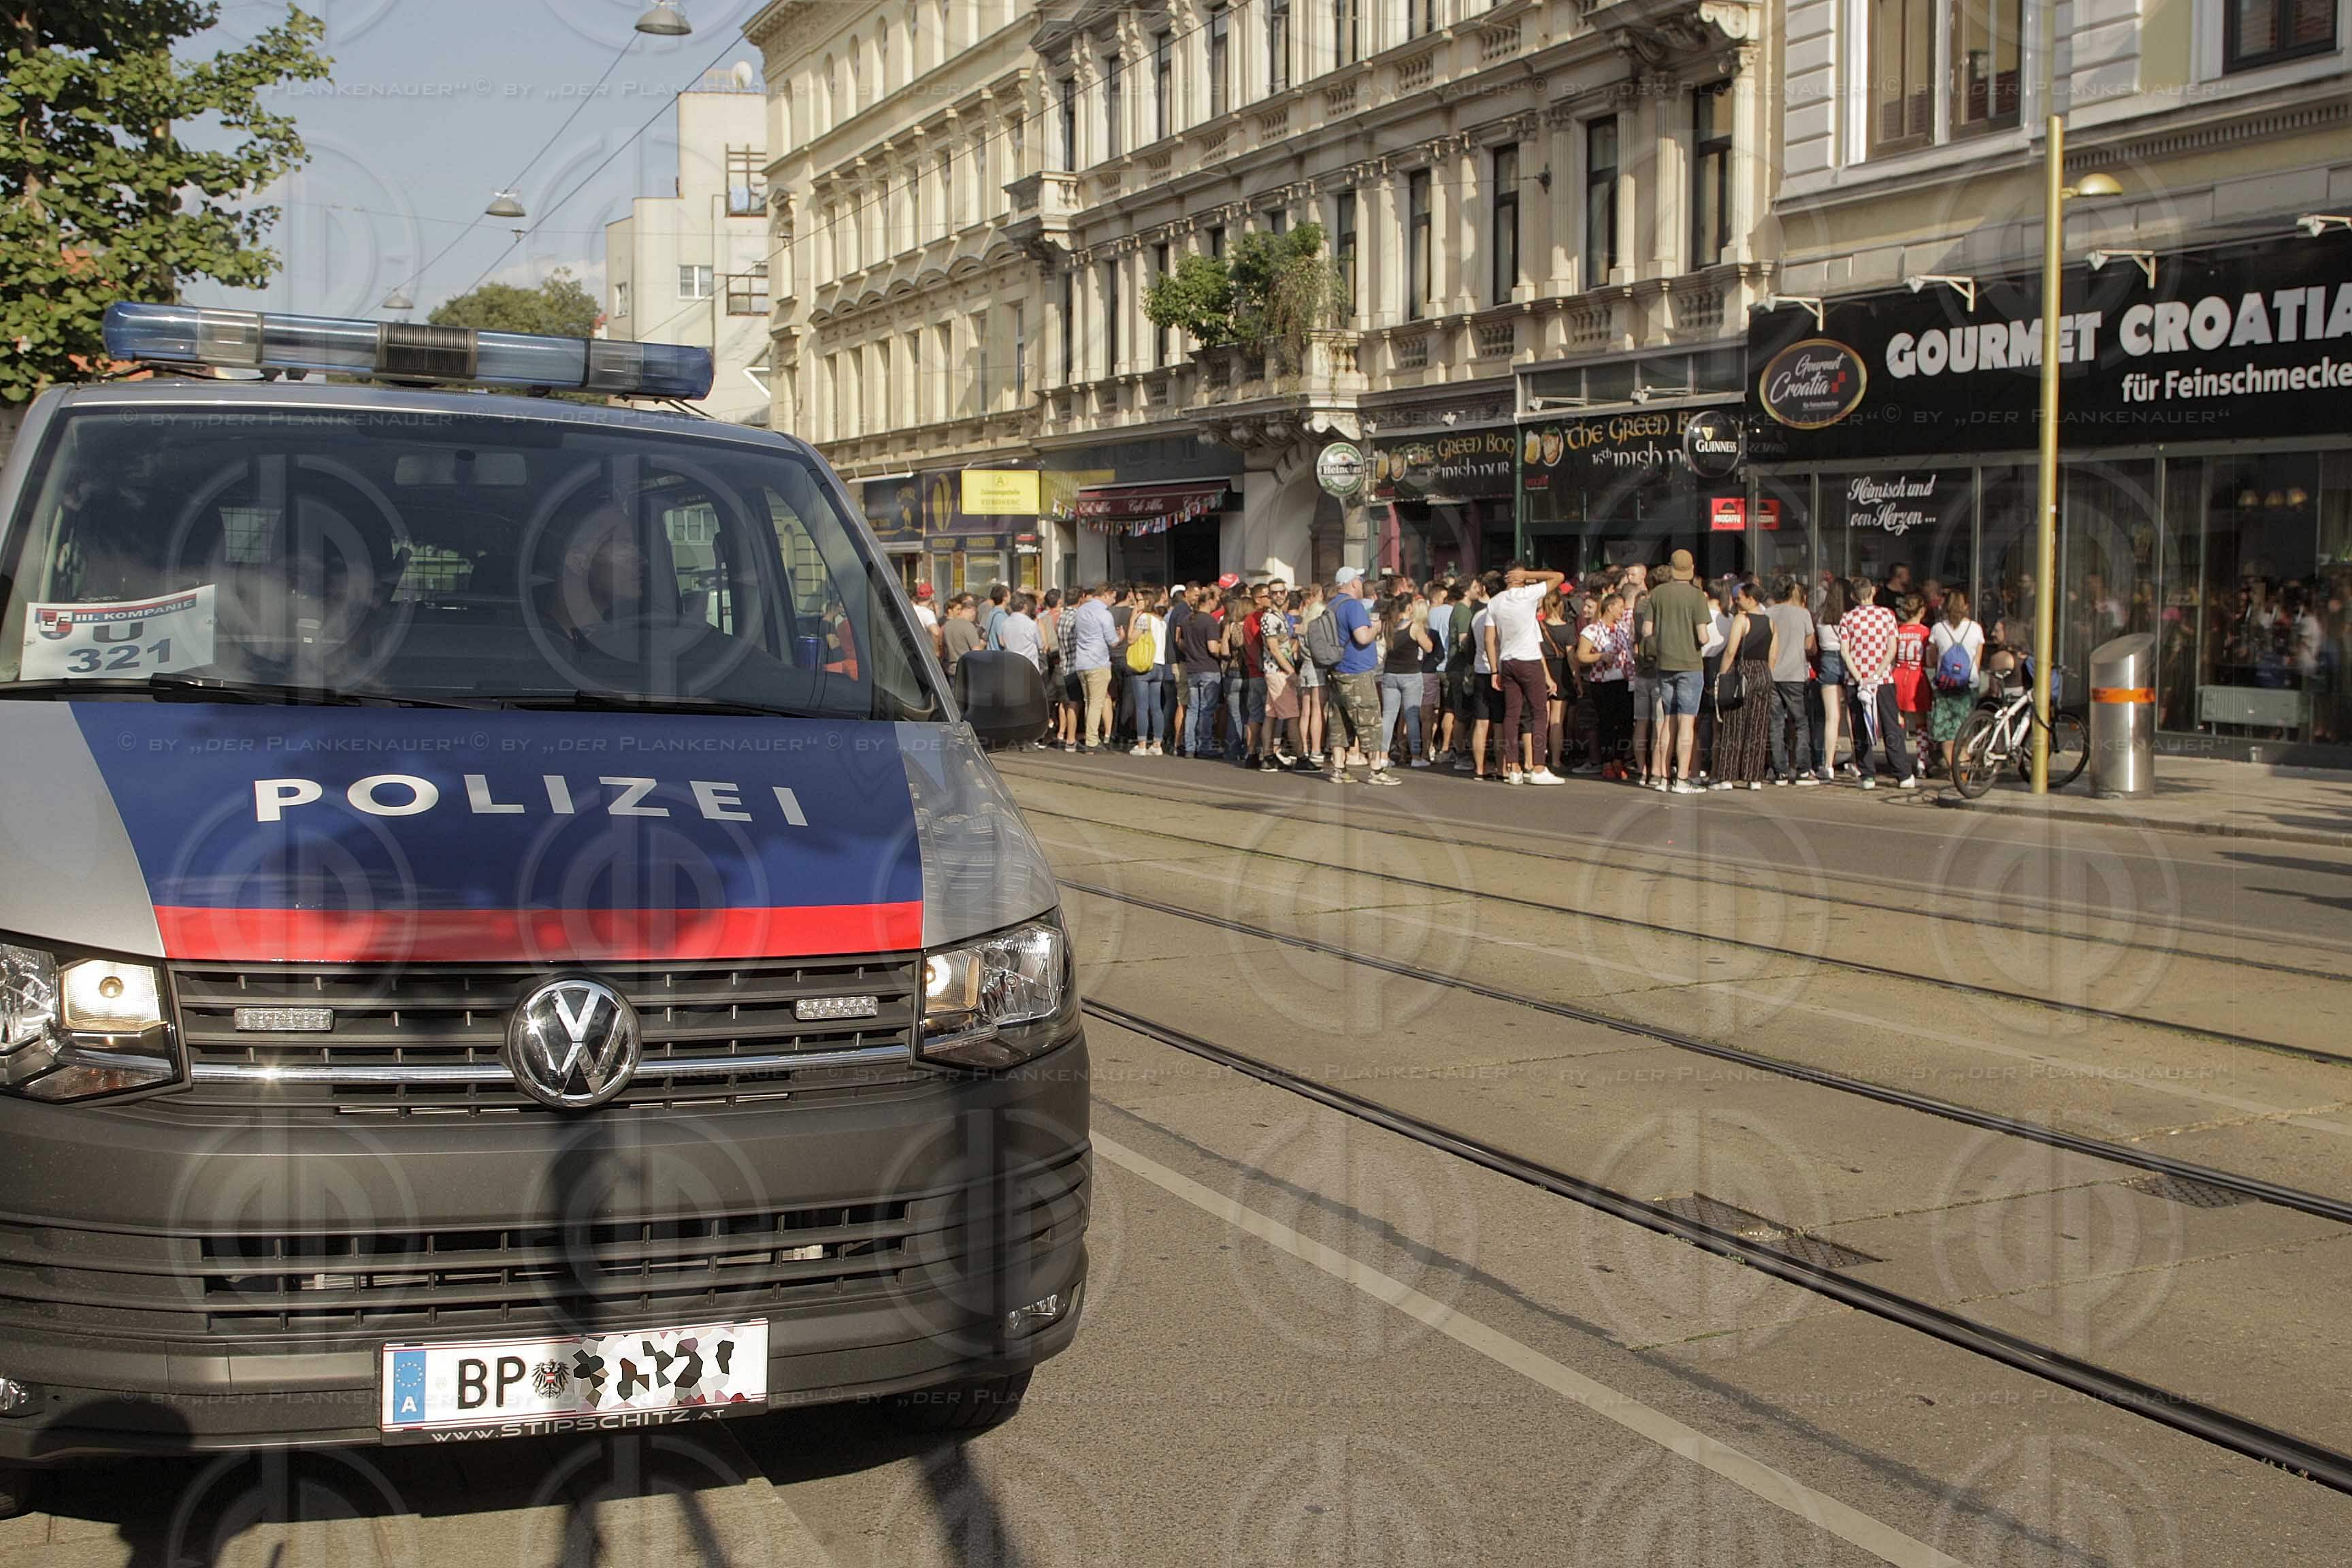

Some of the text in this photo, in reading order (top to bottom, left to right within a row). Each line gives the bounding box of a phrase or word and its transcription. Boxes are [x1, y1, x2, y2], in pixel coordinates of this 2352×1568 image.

[1886, 282, 2352, 379] GOURMET CROATIA
[1795, 353, 1847, 379] Gourmet
[2122, 356, 2352, 402] für Feinschmecke
[1769, 371, 1829, 404] Croatia
[1695, 439, 1737, 453] GUINNESS
[1847, 474, 1936, 505] Heimisch und
[1872, 502, 1923, 536] Herzen
[76, 600, 195, 621] III. KOMPANIE
[93, 621, 144, 643] U
[67, 638, 171, 673] 321
[1898, 640, 1923, 661] 10
[255, 774, 808, 826] POLIZEI
[457, 1356, 527, 1410] BP
[401, 1396, 417, 1413] A
[431, 1408, 725, 1443] WWW.STIPSCHITZ.AT
